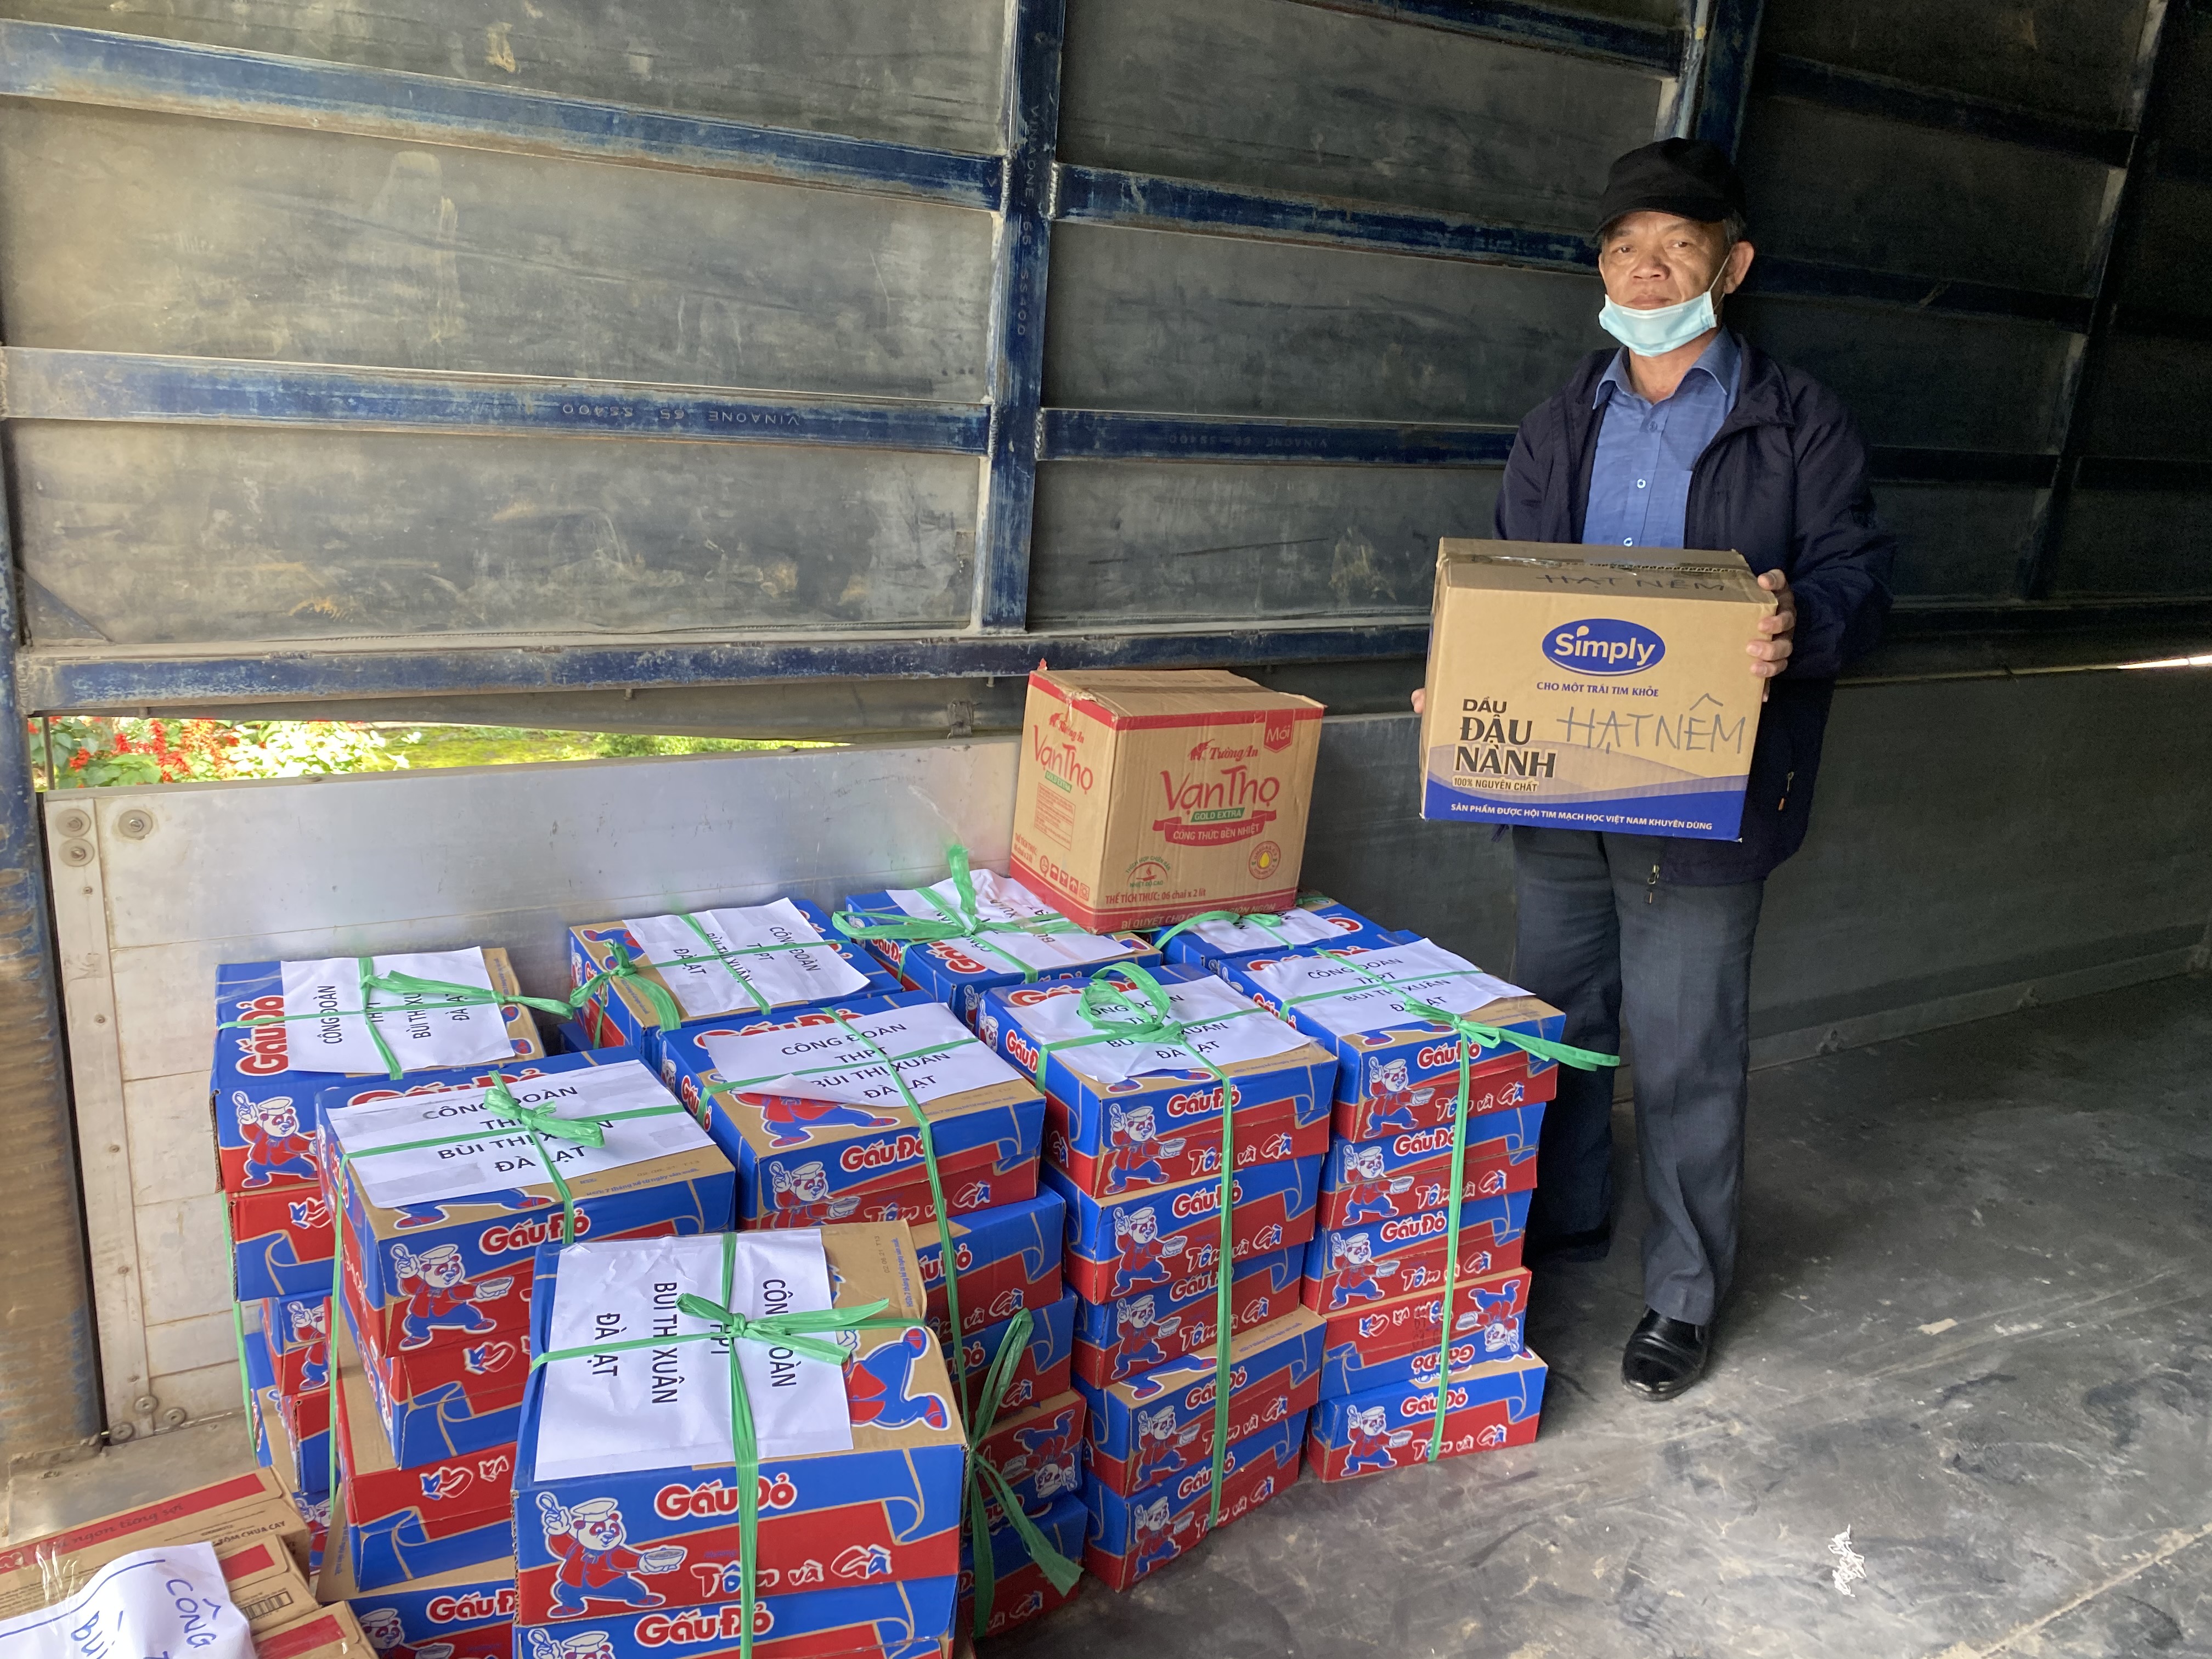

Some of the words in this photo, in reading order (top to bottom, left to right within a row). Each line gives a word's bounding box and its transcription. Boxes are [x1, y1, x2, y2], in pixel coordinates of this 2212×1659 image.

[708, 411, 800, 425] VINAONE
[1554, 625, 1656, 666] Simply
[1536, 681, 1559, 691] CHO
[1561, 682, 1584, 693] MỘT
[1587, 684, 1609, 694] TRÁI
[1612, 686, 1628, 695] TIM
[1459, 714, 1533, 745] ĐẬU
[1455, 744, 1556, 778] NÀNH
[1046, 771, 1057, 783] GOLD
[1454, 777, 1473, 787] 100%
[1475, 779, 1511, 790] NGUYÊN
[1514, 779, 1538, 792] CHẤT
[1194, 812, 1215, 821] GOLD
[1217, 809, 1242, 819] EXTRA
[1451, 803, 1468, 812] SẢN
[1497, 807, 1522, 817] ĐƯỢC
[1524, 809, 1539, 819] HỘI
[1541, 810, 1556, 819] TIM
[1558, 812, 1584, 821] MẠCH
[1585, 814, 1604, 823] HỌC
[1606, 815, 1625, 825] VIỆT
[1626, 817, 1647, 825] NAM
[1649, 819, 1685, 828] KHUYÊN
[1686, 821, 1712, 830] DÙNG
[1173, 830, 1195, 840] CÔNG
[1198, 829, 1219, 840] THỨC
[1220, 827, 1235, 839] BỀN
[1237, 823, 1260, 835] NHIỆT
[1121, 892, 1137, 904] TÍCH
[1161, 891, 1170, 900] 06
[1172, 889, 1187, 899] chai
[1121, 917, 1132, 930] BÍ
[1133, 914, 1164, 928] QUYẾT
[1165, 913, 1186, 924] CHO
[1251, 902, 1276, 913] NGON
[746, 942, 775, 961] TPT
[789, 948, 821, 972] ĐOÀN
[1307, 964, 1350, 980] CÔNG
[1425, 995, 1449, 1008] ẠT
[406, 1023, 431, 1040] BÙI
[781, 1036, 843, 1057] CÔNG
[834, 1047, 889, 1065] THPT
[1156, 1046, 1187, 1059] ĐÀ
[1194, 1040, 1221, 1054] ẠT
[891, 1052, 952, 1071] XUÂN
[863, 1082, 900, 1099] ĐÀ
[1496, 1081, 1525, 1104] Gà
[437, 1143, 484, 1160] BÙI
[489, 1134, 535, 1149] THỊ
[1237, 1144, 1257, 1165] và
[1260, 1132, 1291, 1159] Gà
[494, 1156, 537, 1172] ĐÀ
[1479, 1170, 1506, 1194] Gà
[952, 1181, 991, 1209] Gà
[1252, 1223, 1283, 1250] Gà
[883, 1265, 890, 1273] 02
[1464, 1251, 1491, 1274] Gà
[763, 1279, 793, 1316] CÔN
[989, 1288, 1024, 1317] Gà
[1241, 1296, 1269, 1324] Gà
[594, 1312, 628, 1341] ĐÀ
[653, 1314, 678, 1339] TH
[1358, 1313, 1390, 1338] Gà
[586, 1354, 618, 1376] ẠT
[651, 1347, 685, 1404] XUÂN
[768, 1346, 802, 1387] OÀN
[1476, 1424, 1507, 1447] Gà
[241, 1526, 268, 1538] CHUA
[268, 1520, 286, 1531] CAY
[788, 1559, 824, 1586] và
[831, 1544, 893, 1579] Gà
